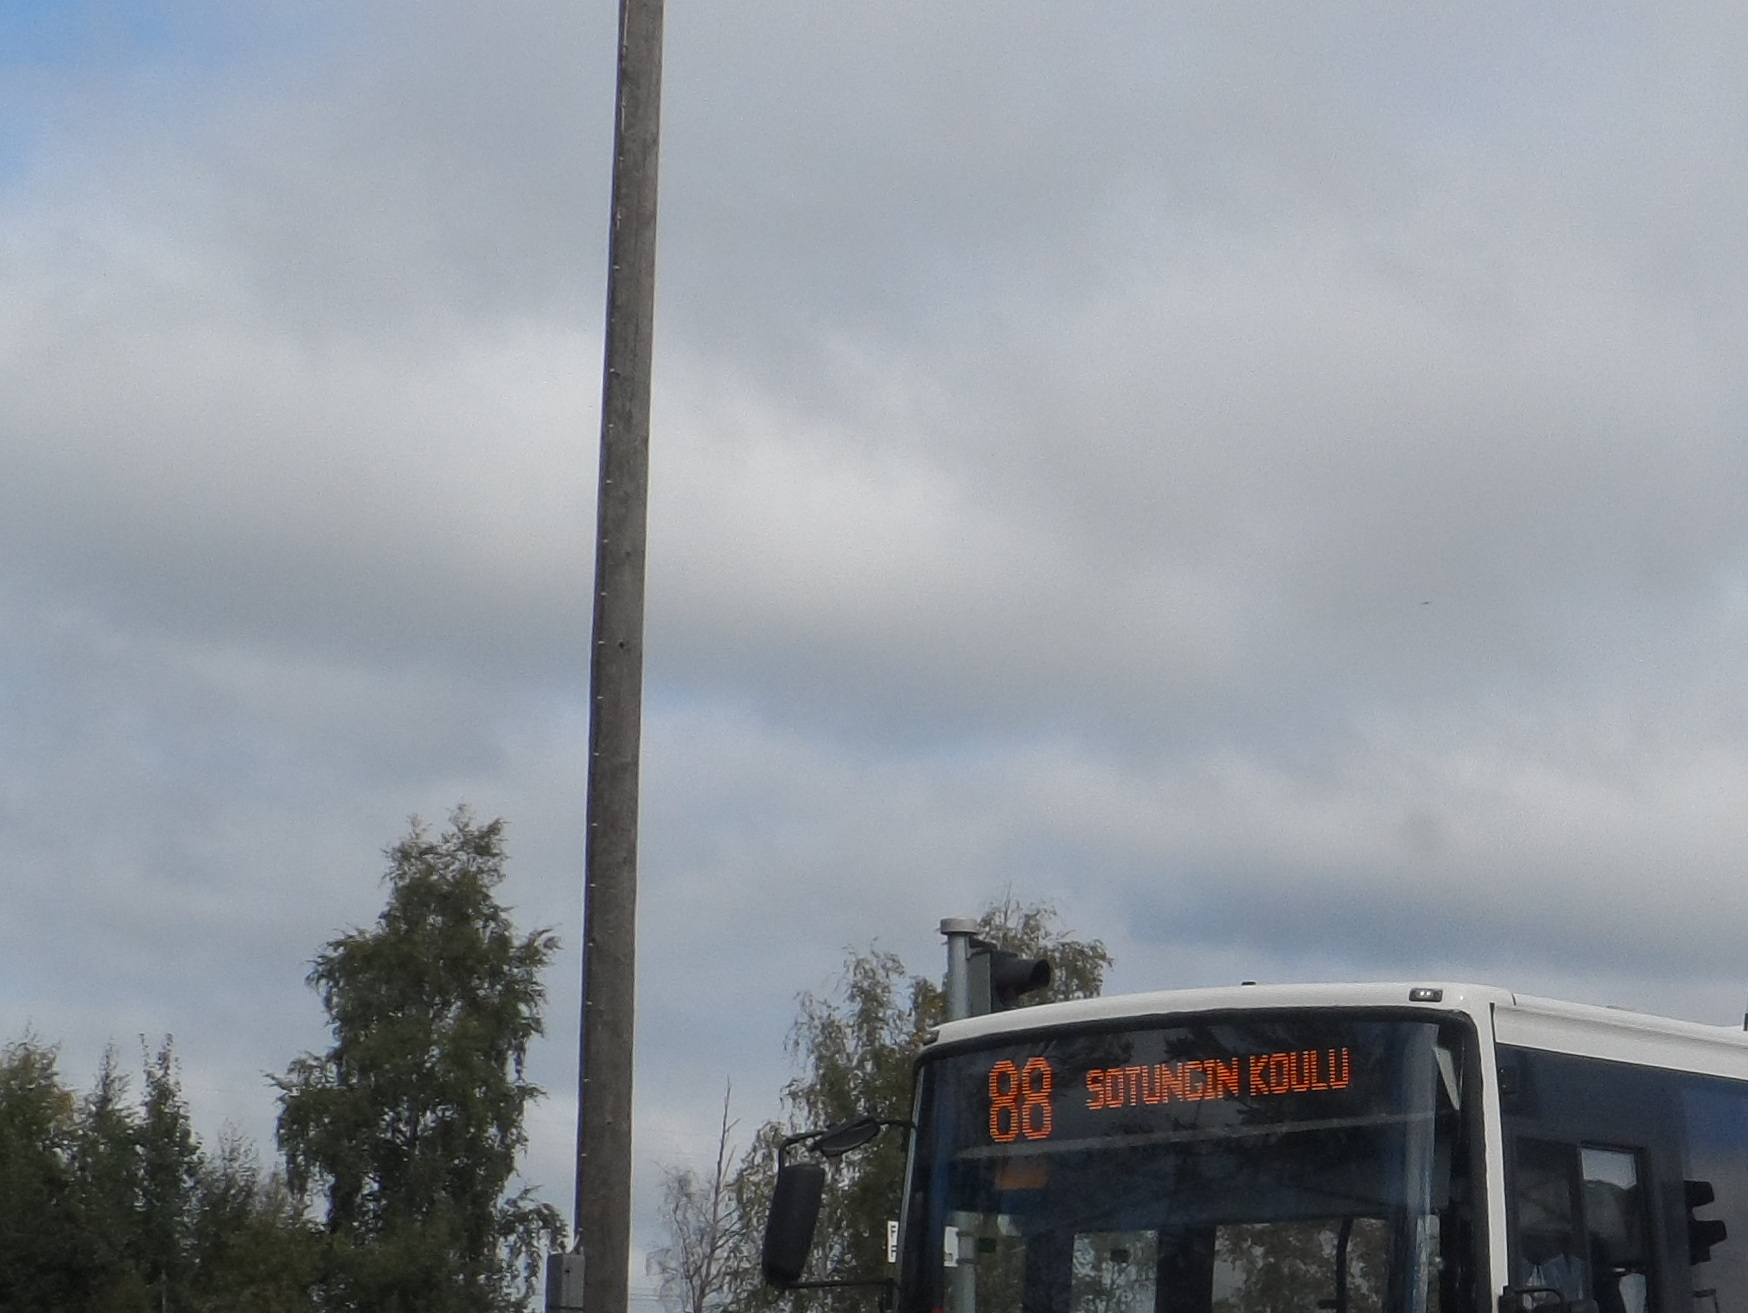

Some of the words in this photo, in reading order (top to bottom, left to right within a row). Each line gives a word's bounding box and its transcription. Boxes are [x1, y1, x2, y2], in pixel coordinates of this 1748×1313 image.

[988, 1056, 1053, 1142] 88
[1085, 1056, 1240, 1111] SOTUNGIN
[1249, 1047, 1350, 1097] KOULU
